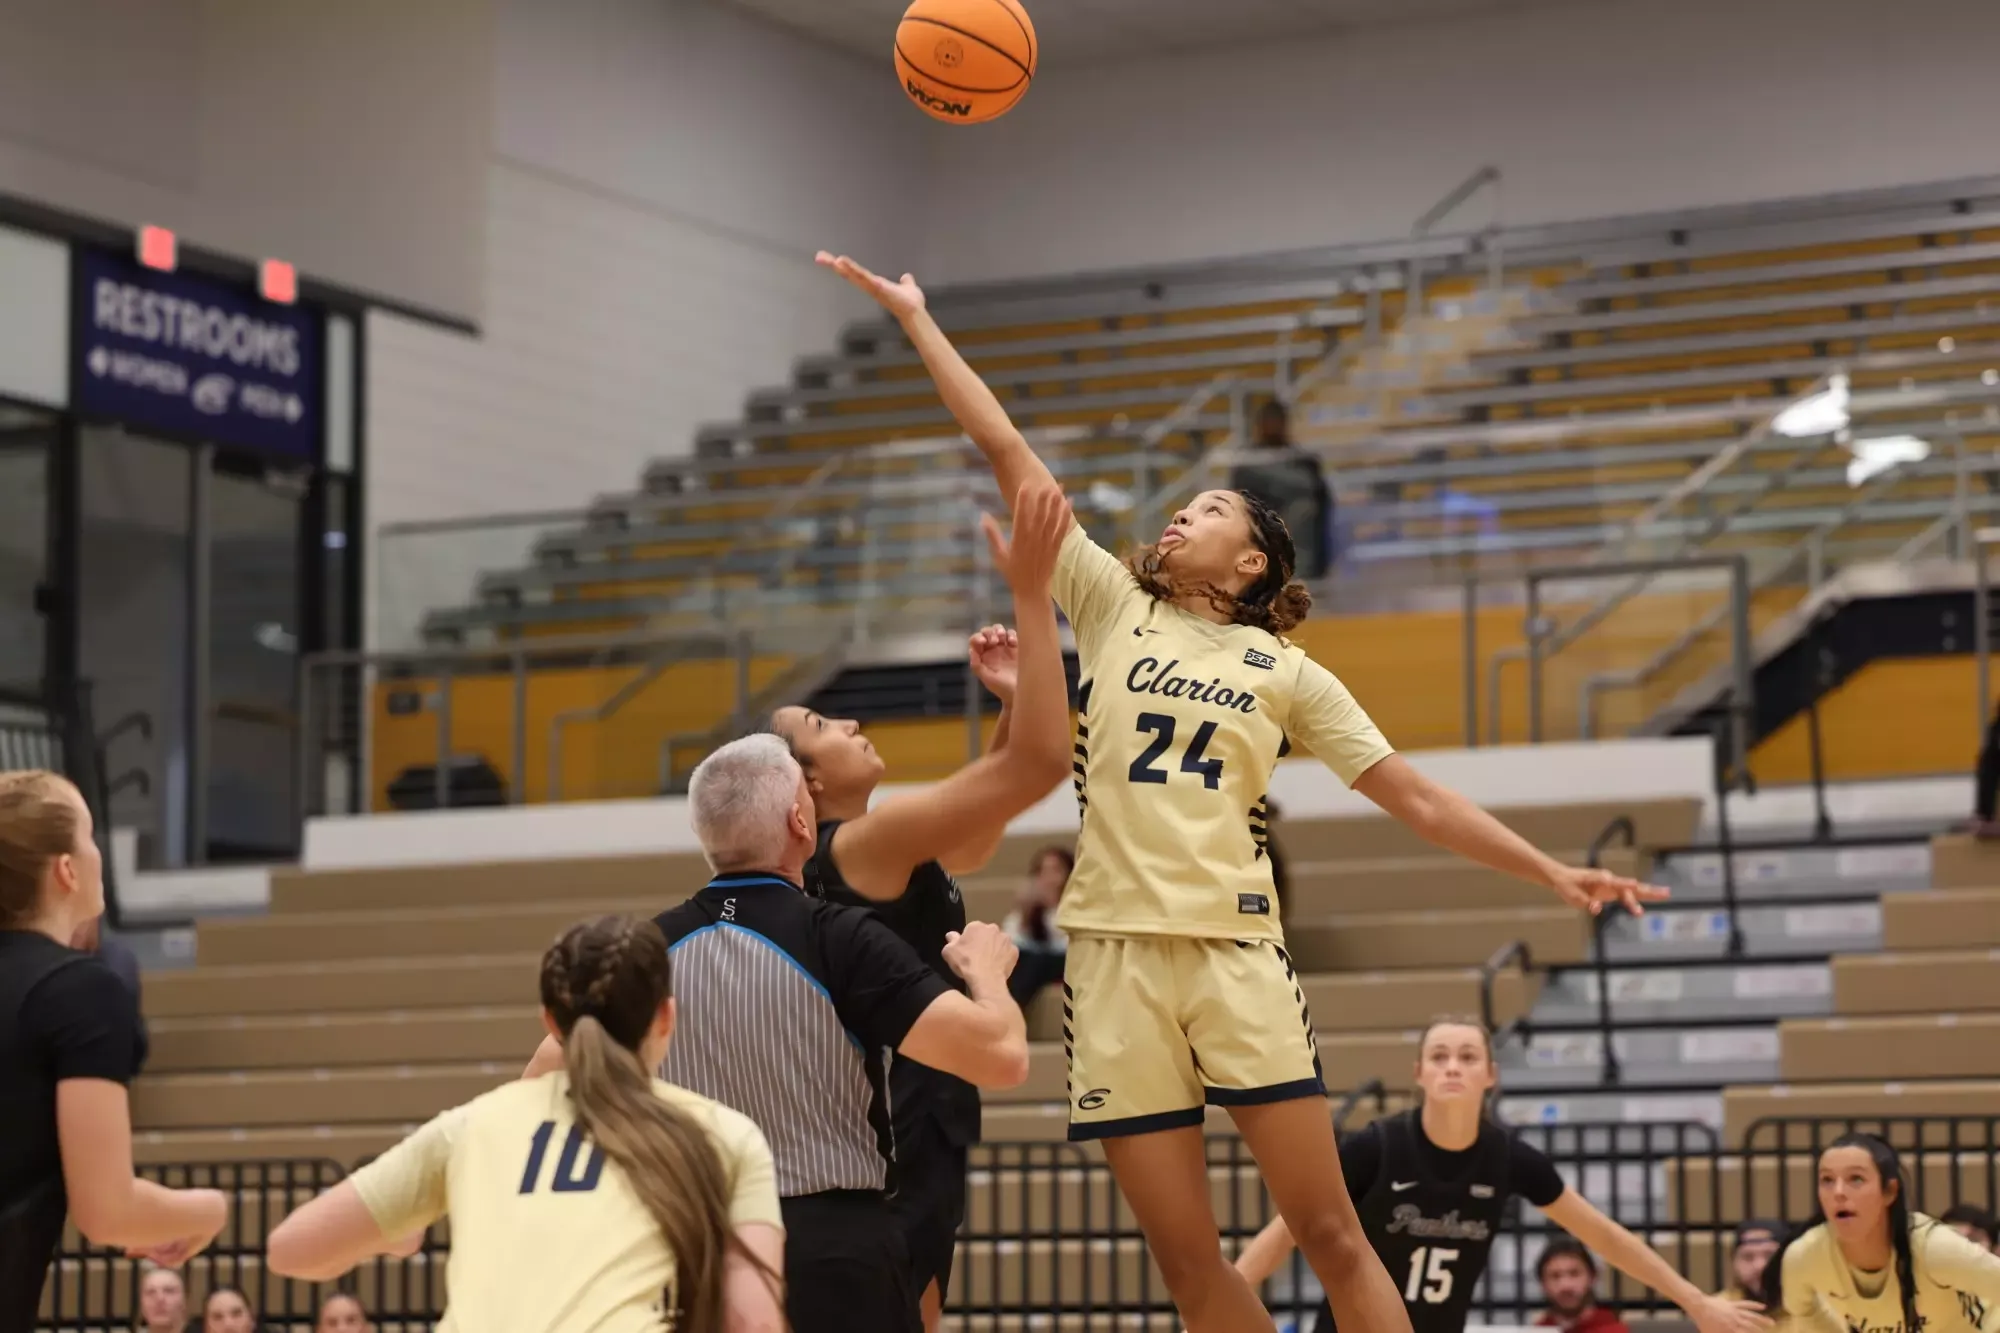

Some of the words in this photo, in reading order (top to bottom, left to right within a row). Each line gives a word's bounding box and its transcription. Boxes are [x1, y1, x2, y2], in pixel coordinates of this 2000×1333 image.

[907, 76, 972, 116] NCAA
[95, 277, 300, 377] RESTROOMS
[1126, 657, 1257, 713] Clarion
[1245, 651, 1276, 668] PSAC
[1128, 712, 1224, 790] 24
[518, 1120, 607, 1194] 10
[1405, 1246, 1460, 1303] 15
